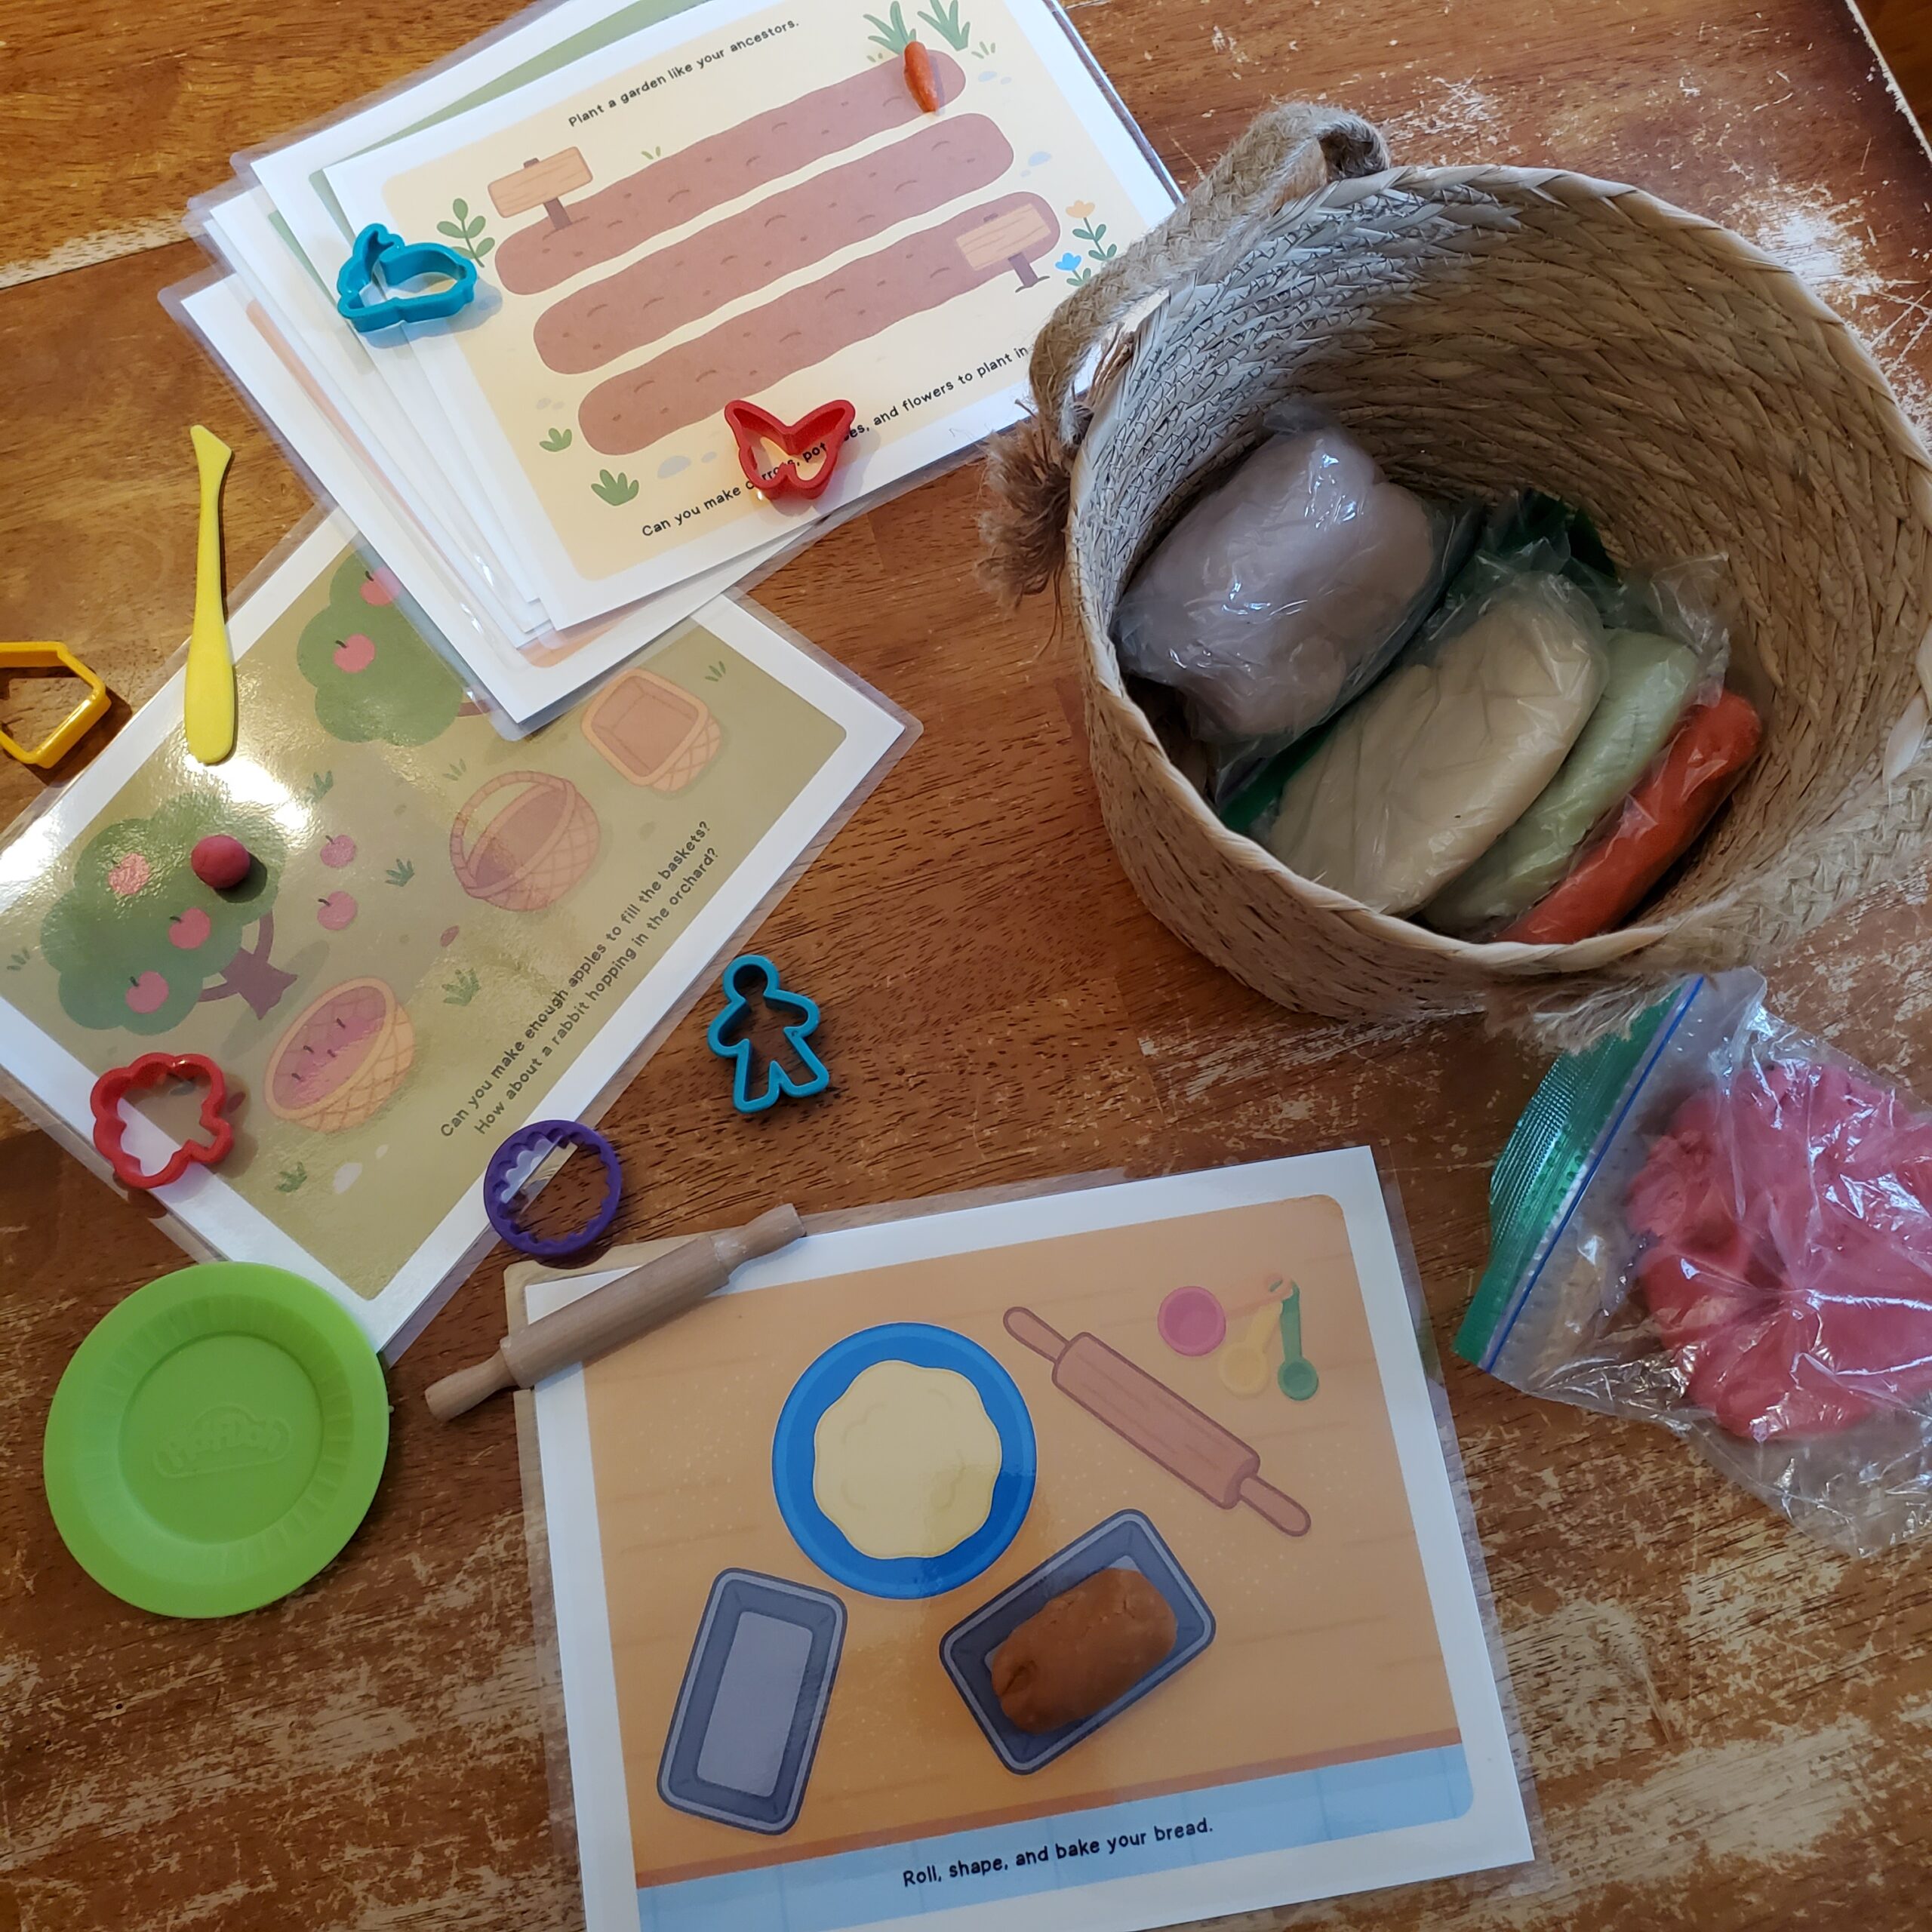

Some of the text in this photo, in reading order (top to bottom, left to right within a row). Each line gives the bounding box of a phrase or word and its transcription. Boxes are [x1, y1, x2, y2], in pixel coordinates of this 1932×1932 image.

[568, 20, 799, 127] Plant a garden like your ancestors.
[642, 519, 671, 536] Can
[674, 506, 700, 525] you
[703, 488, 741, 509] make
[802, 424, 869, 463] potes,
[873, 406, 899, 426] and
[903, 381, 954, 411] flowers
[958, 373, 973, 384] to
[977, 353, 1012, 378] plant
[1014, 346, 1029, 358] in
[441, 821, 710, 1137] Can you make enough apples to fill the baskets?
[474, 848, 718, 1134] How about a rabbit hopping in the orchard?
[903, 1817, 1213, 1887] Roll, shape, and bake your bread.
